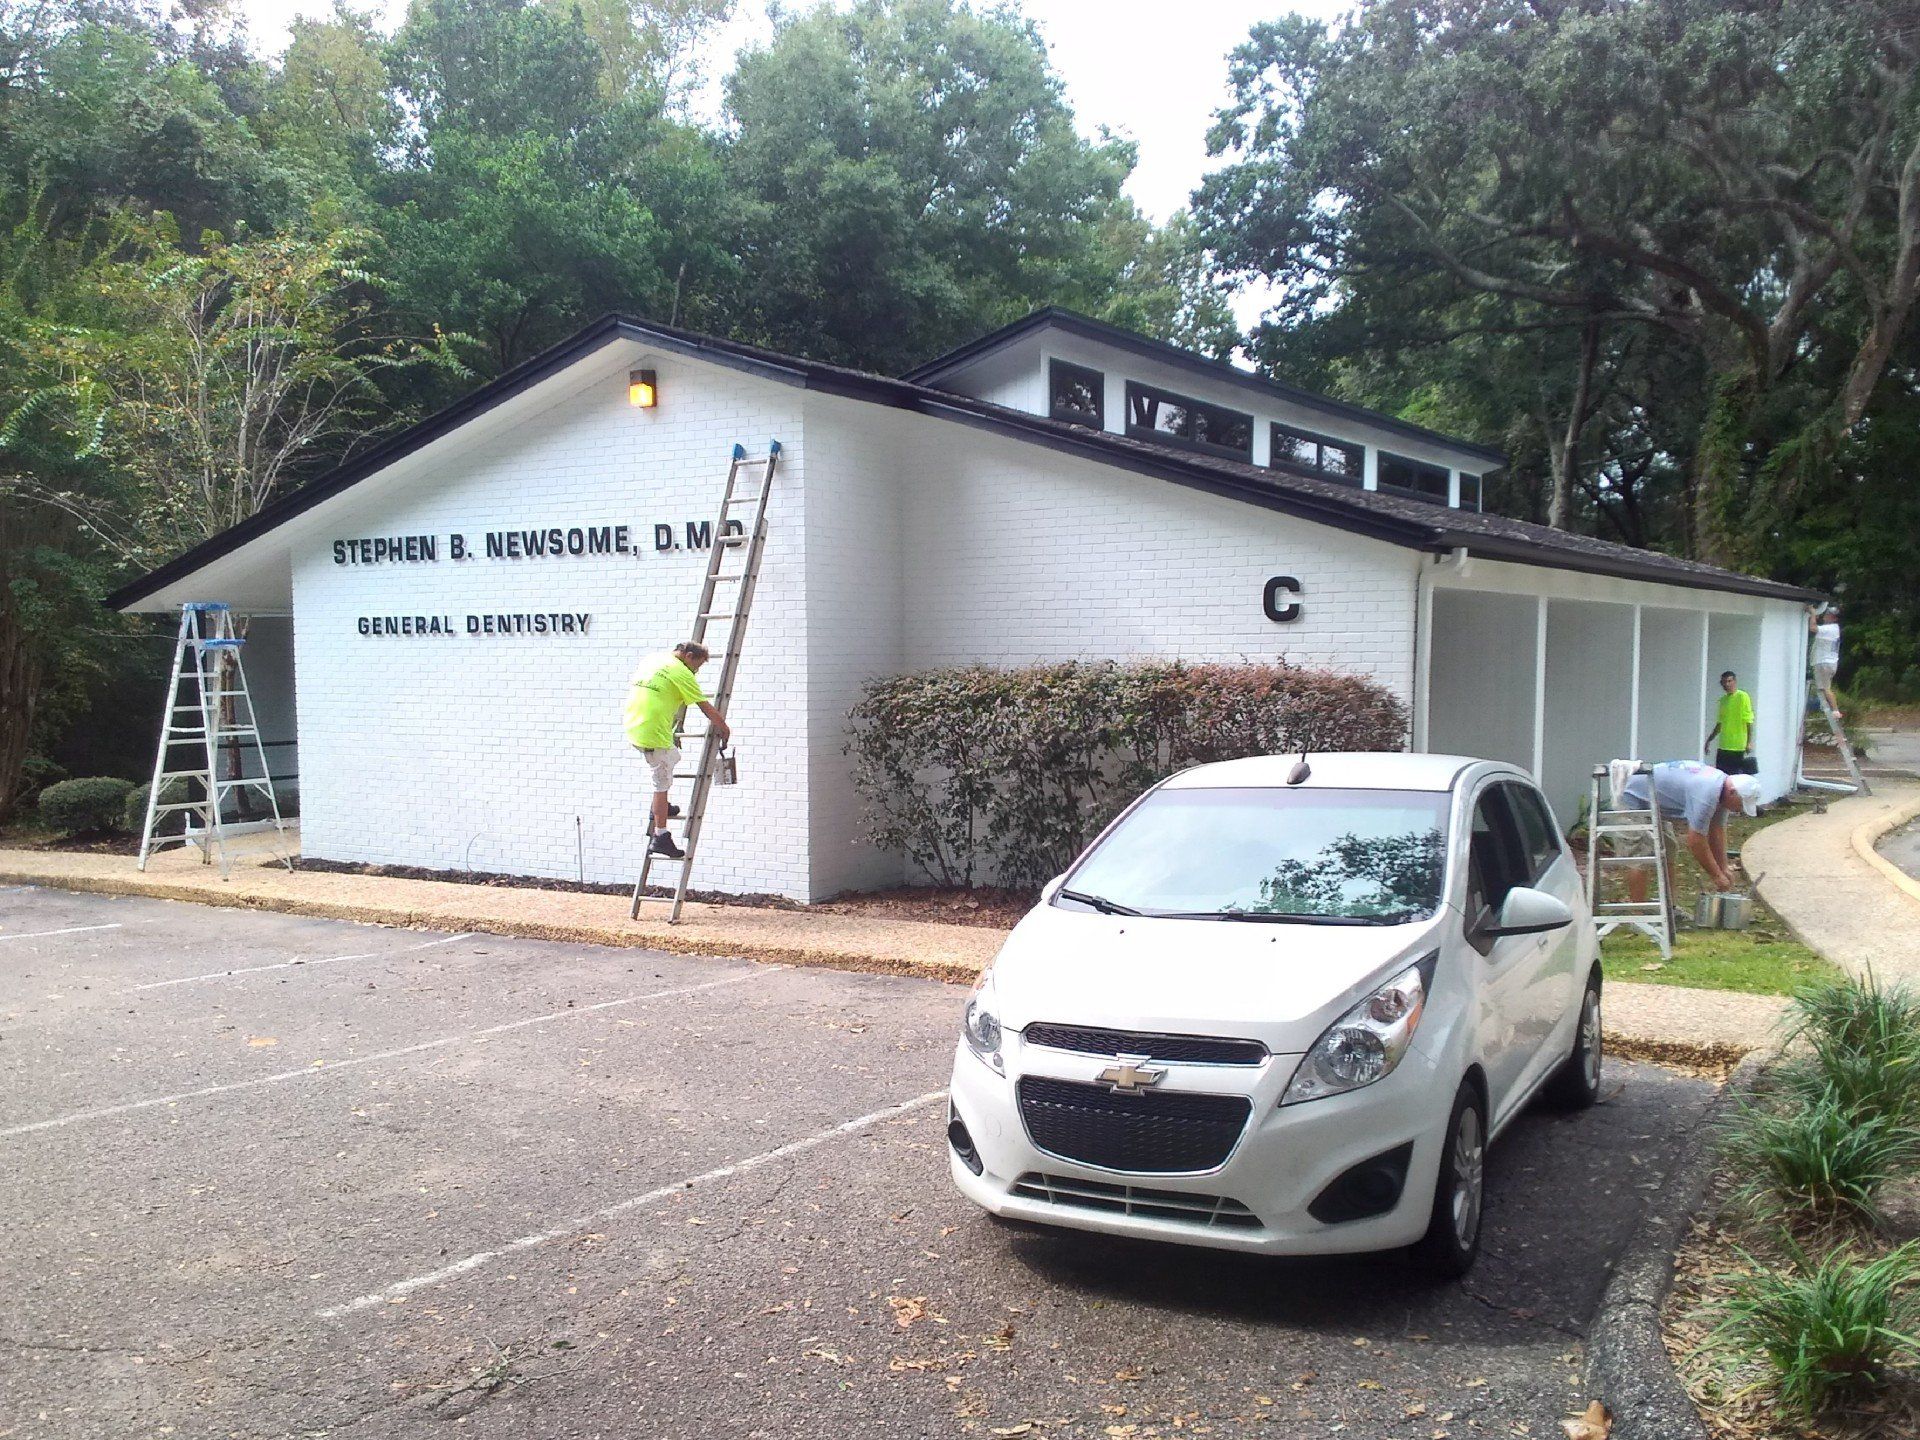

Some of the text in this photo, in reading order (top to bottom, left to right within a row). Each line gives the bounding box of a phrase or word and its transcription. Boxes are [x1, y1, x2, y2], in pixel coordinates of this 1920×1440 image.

[333, 519, 743, 564] STEPHEN B. NEWSOME, D.MD
[1263, 576, 1300, 622] C
[358, 613, 590, 635] GENERAL DENTISTRY
